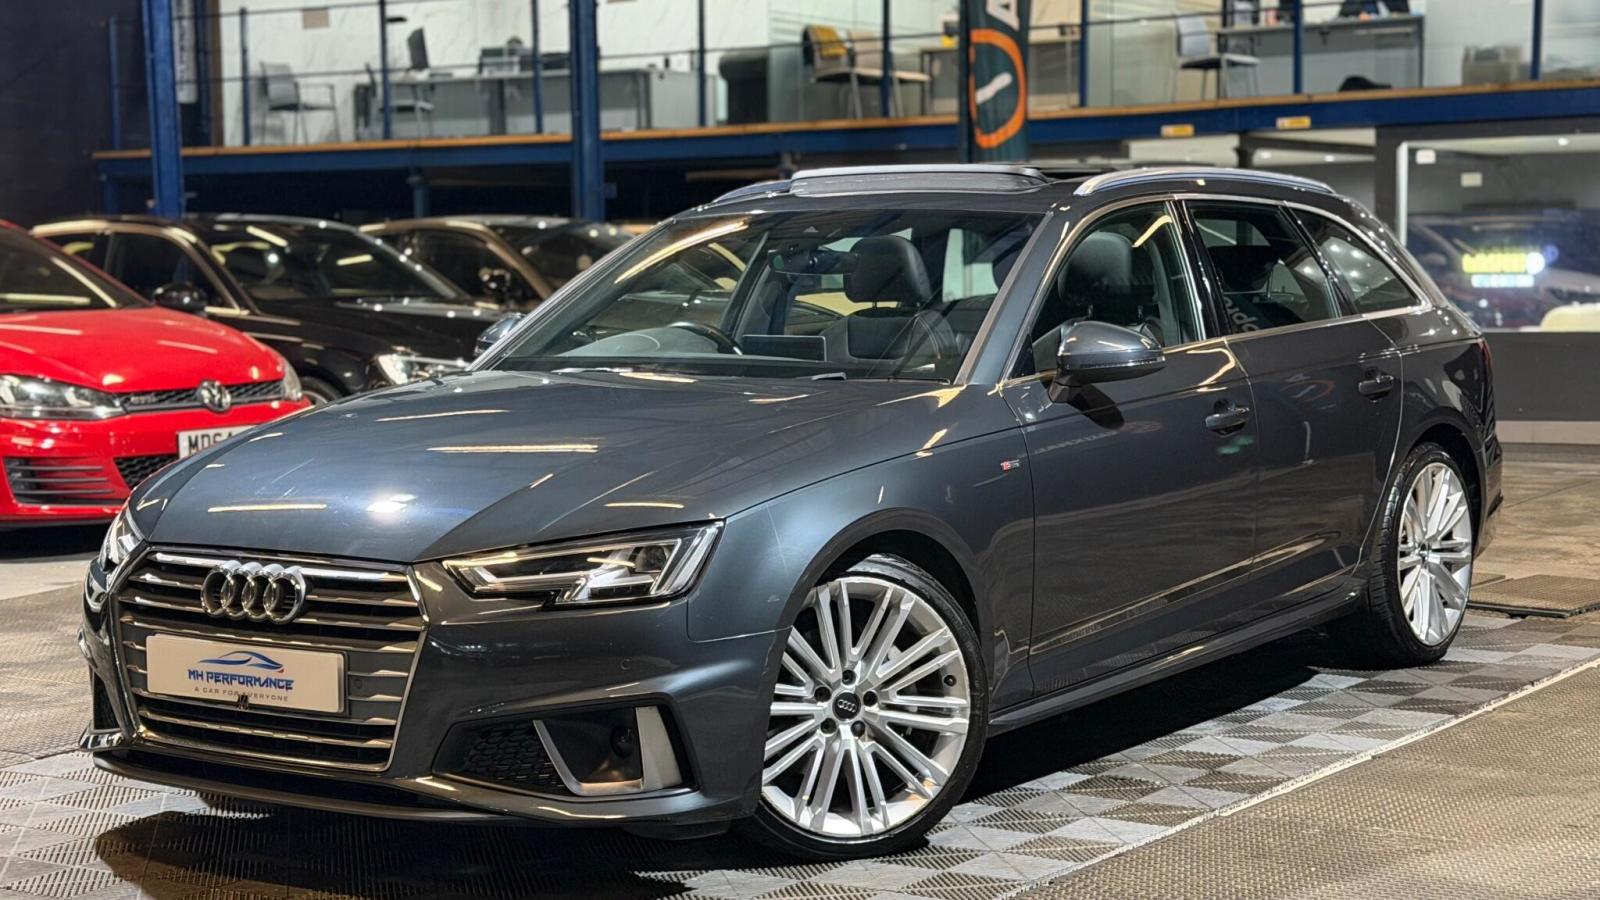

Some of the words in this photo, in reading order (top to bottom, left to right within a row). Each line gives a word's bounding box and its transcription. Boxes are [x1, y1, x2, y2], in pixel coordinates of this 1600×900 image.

[188, 669, 204, 681] MH
[206, 671, 295, 691] PERFORMANCE
[222, 689, 240, 697] FOR
